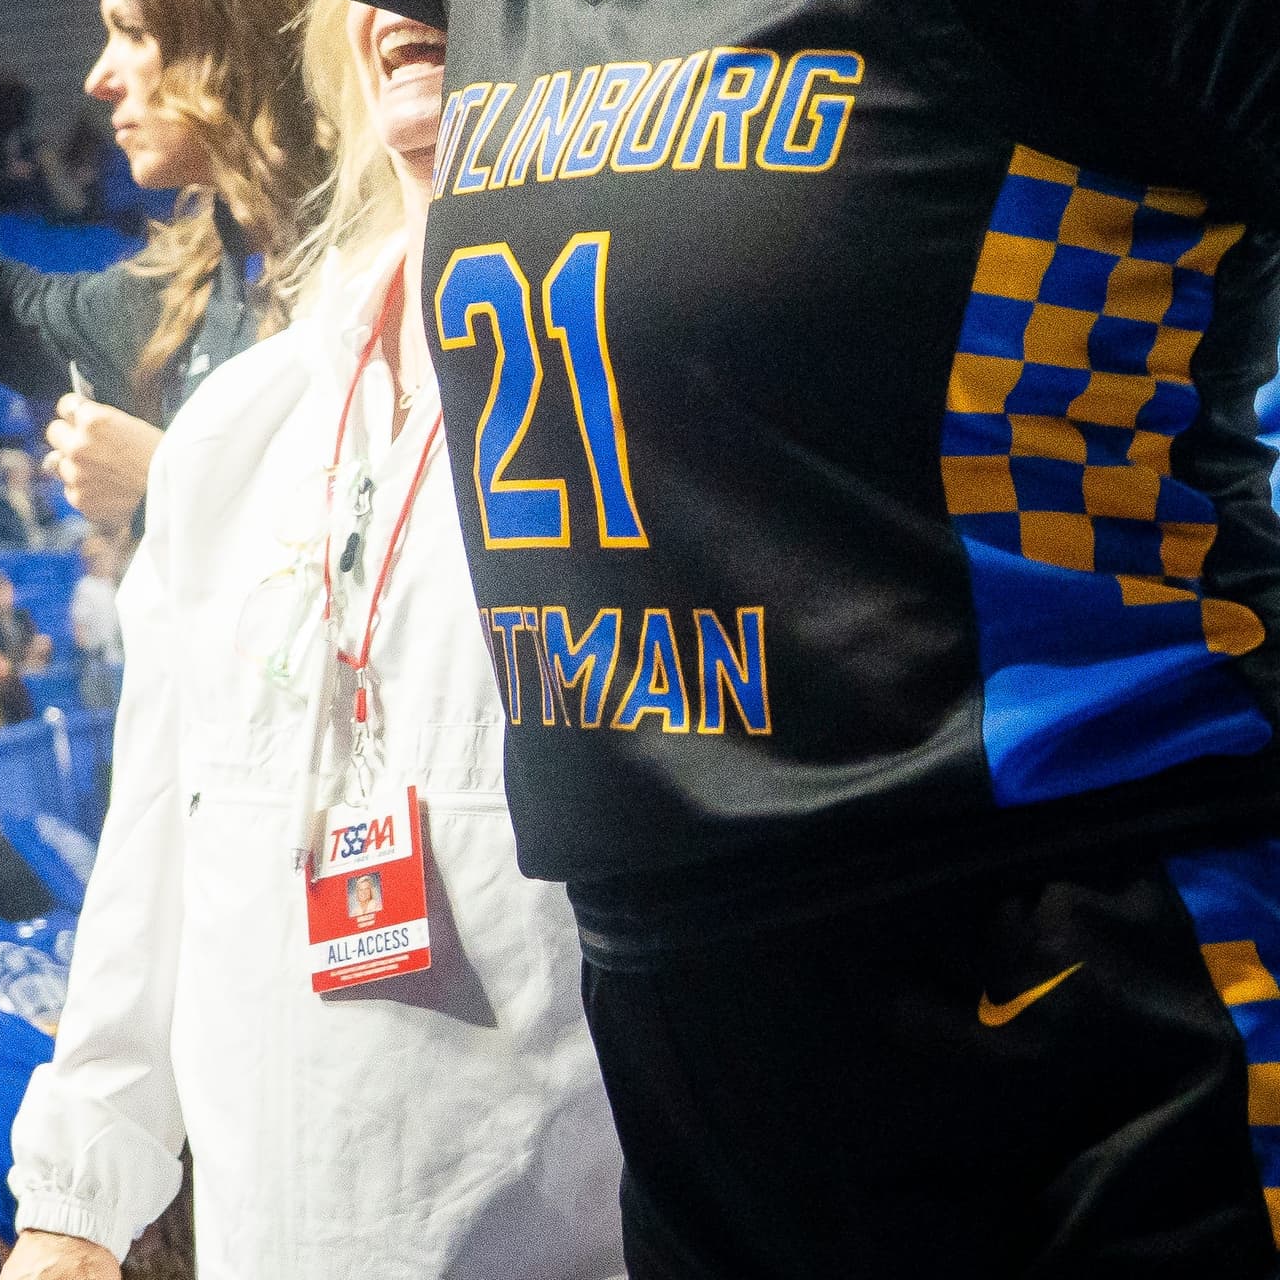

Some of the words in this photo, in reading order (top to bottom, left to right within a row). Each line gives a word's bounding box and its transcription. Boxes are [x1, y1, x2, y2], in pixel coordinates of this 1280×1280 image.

[434, 230, 650, 550] 21
[330, 816, 395, 862] TSSAA
[328, 928, 409, 965] ALL-ACCESS
